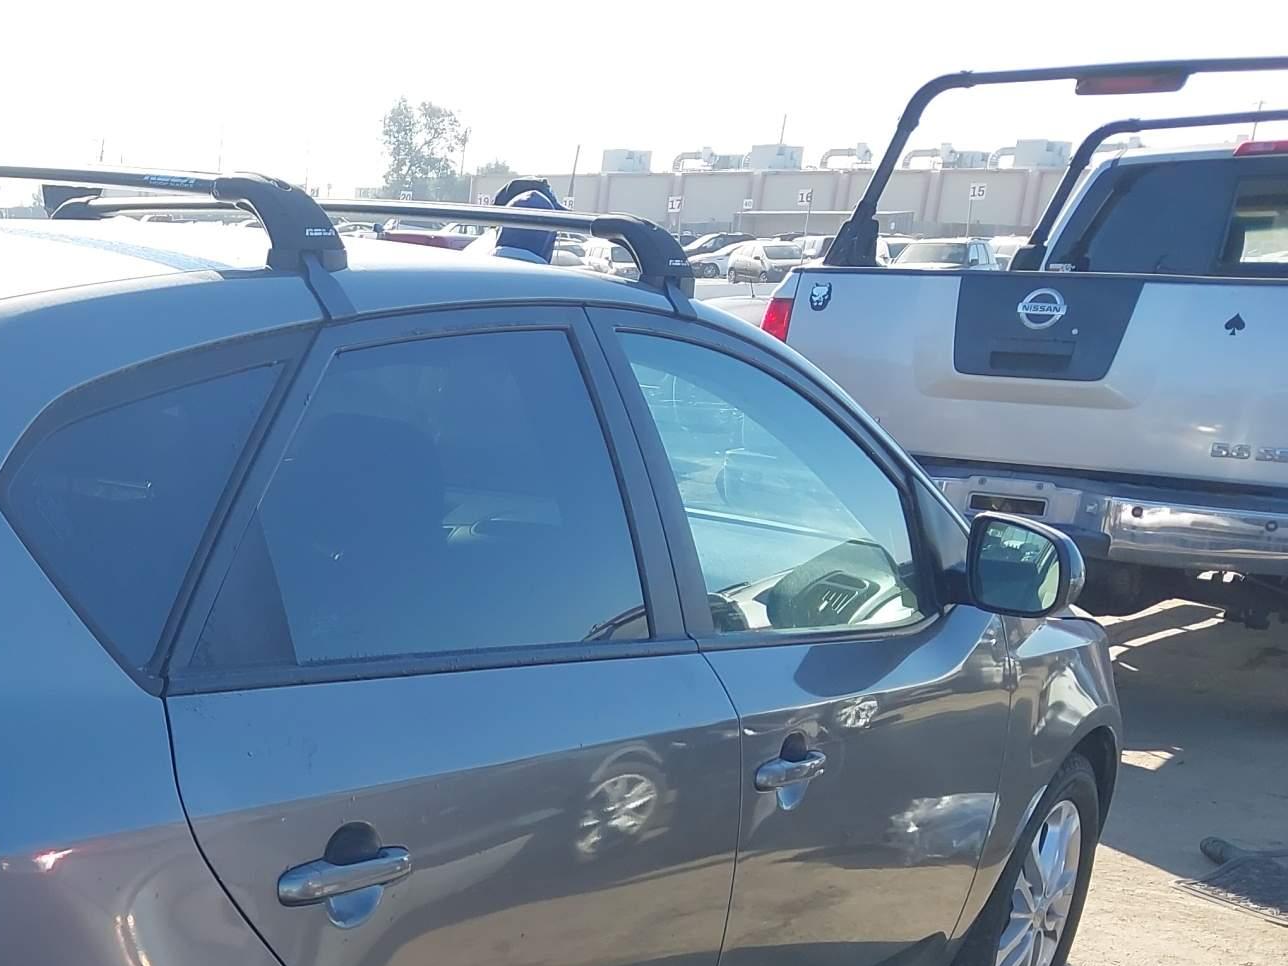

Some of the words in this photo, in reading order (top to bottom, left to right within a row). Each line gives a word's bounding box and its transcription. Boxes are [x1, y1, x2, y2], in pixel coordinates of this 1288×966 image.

[970, 185, 985, 198] 15
[669, 199, 683, 210] 17
[1021, 304, 1062, 313] NISSAN
